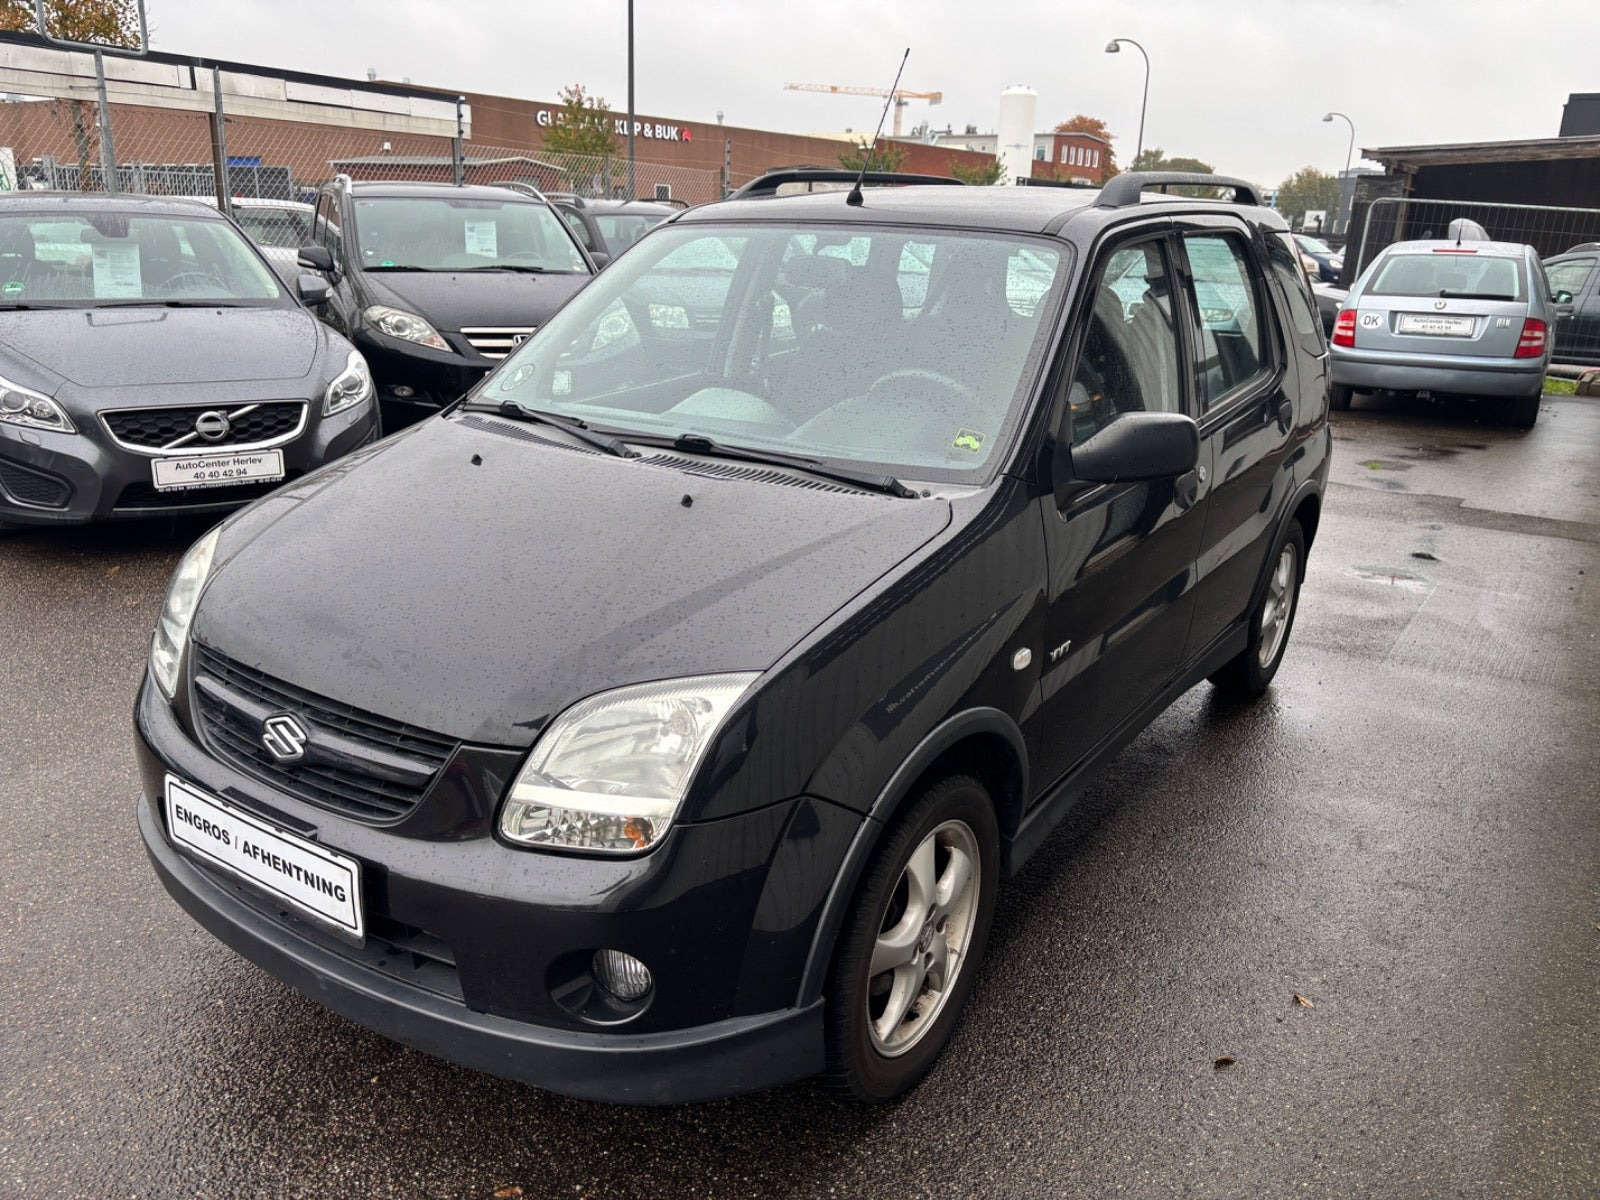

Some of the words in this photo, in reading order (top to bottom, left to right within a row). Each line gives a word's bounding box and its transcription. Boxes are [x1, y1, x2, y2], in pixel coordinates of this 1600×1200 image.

[615, 119, 642, 136] KLP
[643, 123, 653, 138] &
[655, 124, 679, 141] BUK
[1363, 315, 1379, 327] DK
[175, 458, 230, 471] AutoCenter
[232, 456, 263, 467] Herlev
[193, 471, 206, 480] 40
[207, 470, 220, 479] 40
[222, 469, 234, 478] 42
[235, 468, 248, 477] 94
[175, 803, 231, 846] ENGROS
[242, 840, 347, 903] AFHENTNING
